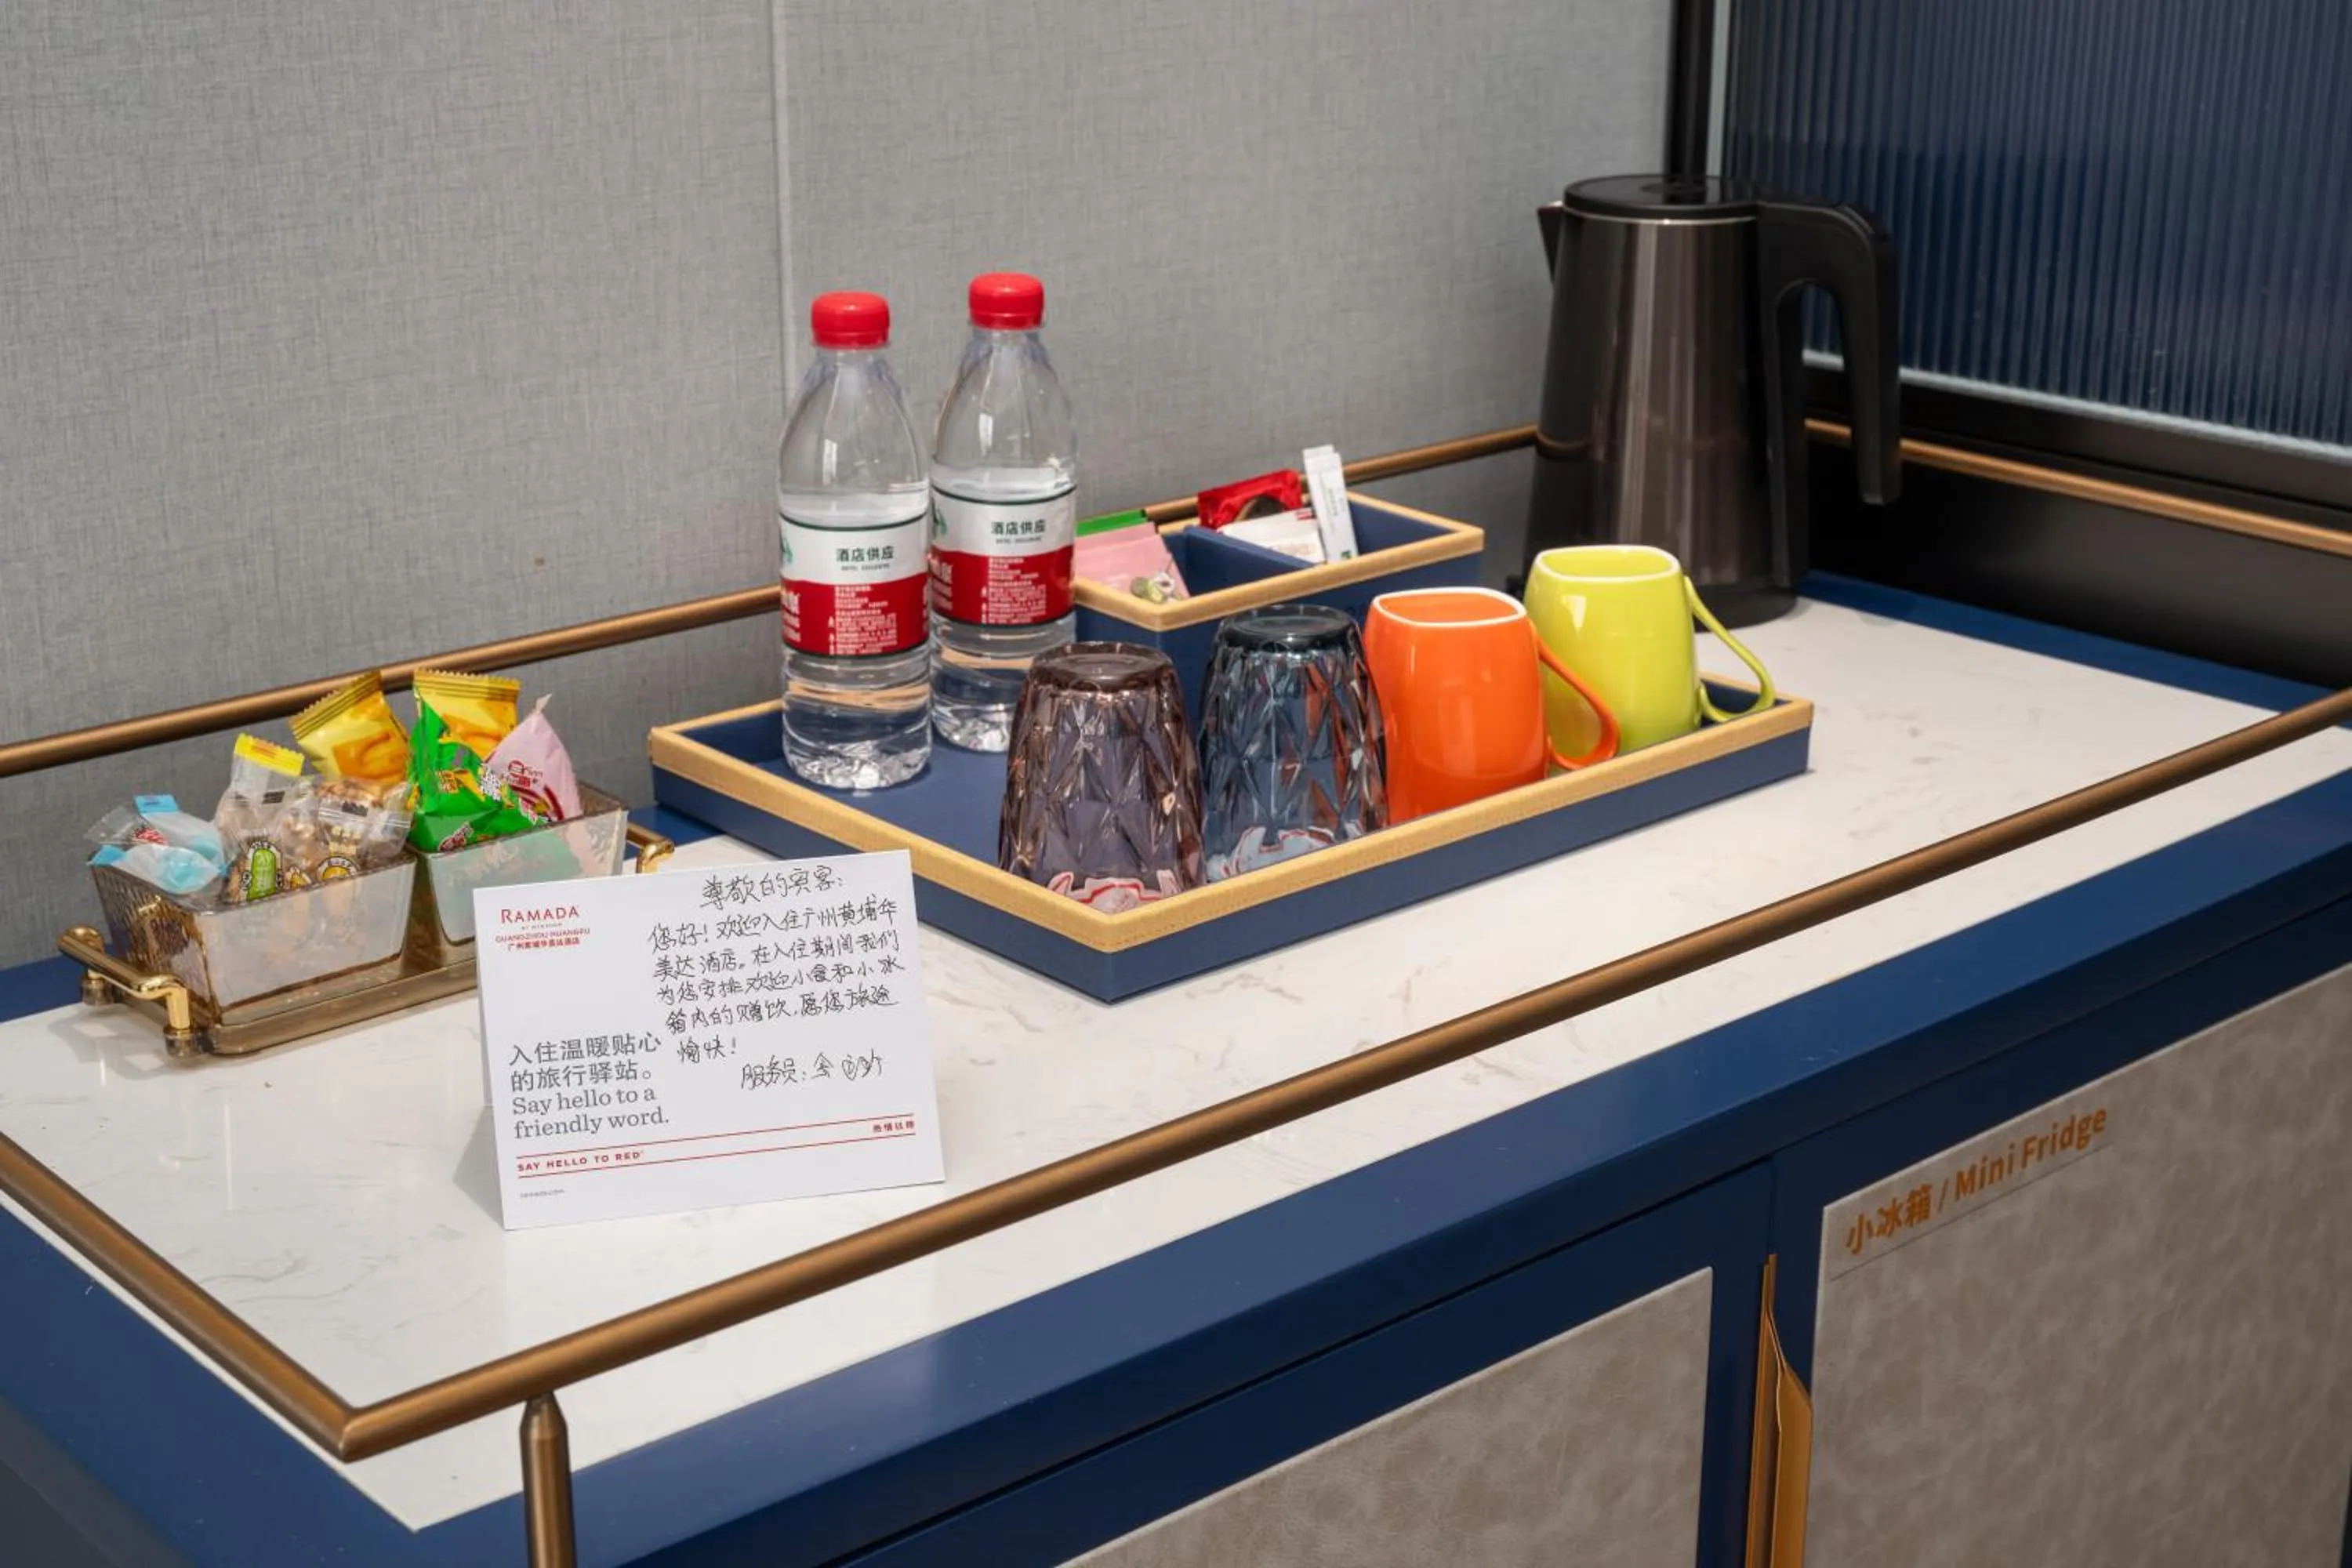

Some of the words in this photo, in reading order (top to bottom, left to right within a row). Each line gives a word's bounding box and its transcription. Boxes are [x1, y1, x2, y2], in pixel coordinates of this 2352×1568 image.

[991, 519, 1046, 535] 酒店供应
[836, 546, 894, 562] 酒店供应
[501, 906, 579, 924] RAMADA
[510, 1031, 662, 1066] 入住温暖贴心
[510, 1058, 652, 1092] 的旅行驿站。
[513, 1097, 552, 1116] Say
[557, 1088, 612, 1110] hello
[616, 1089, 638, 1104] to
[644, 1087, 655, 1101] a
[514, 1114, 603, 1139] friendly
[608, 1105, 670, 1129] word.
[517, 1162, 540, 1172] SAY
[546, 1156, 587, 1168] HELLO
[594, 1155, 609, 1164] TO
[615, 1152, 641, 1162] RED
[1846, 1183, 1933, 1256] 小冰箱
[1955, 1142, 2015, 1202] Mini
[2021, 1108, 2107, 1171] Fridge
